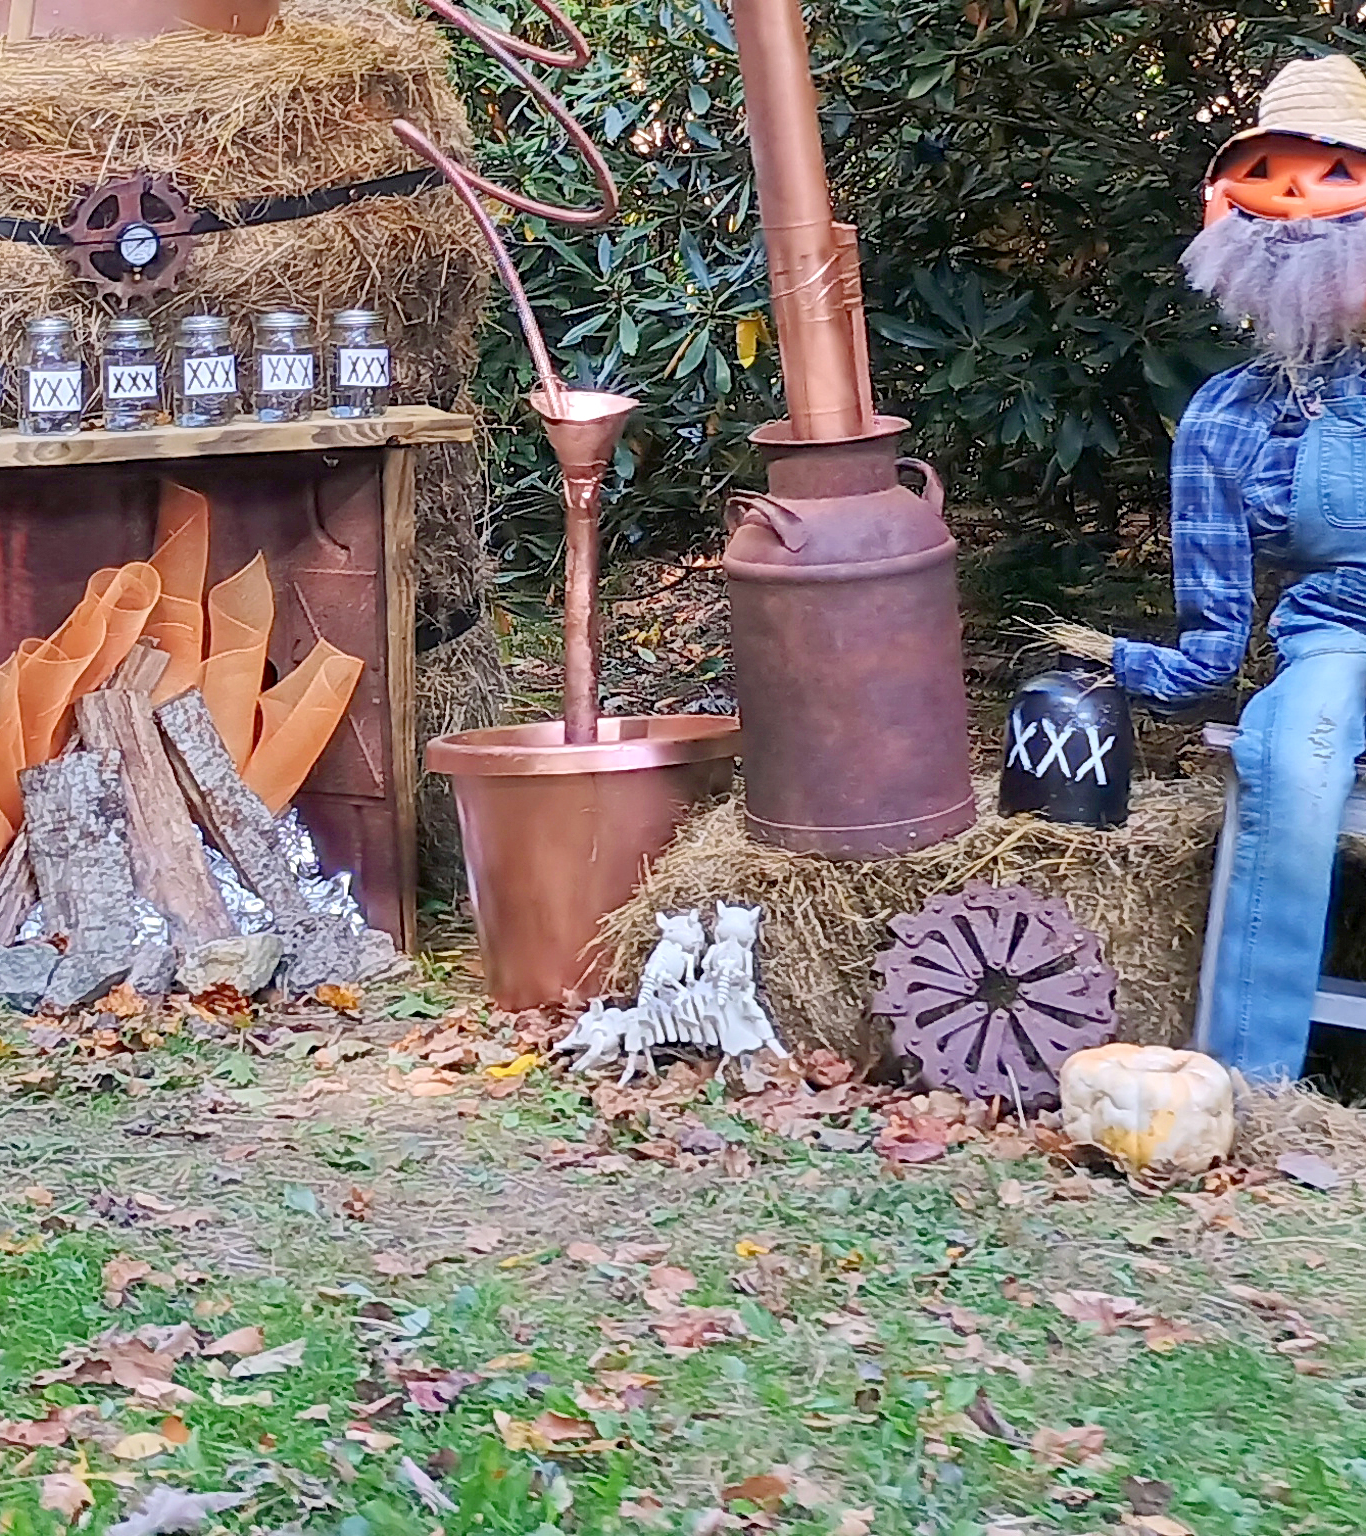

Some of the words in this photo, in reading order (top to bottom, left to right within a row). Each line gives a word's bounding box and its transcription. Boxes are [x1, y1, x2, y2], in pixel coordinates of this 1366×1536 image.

[113, 371, 153, 394] XXX
[187, 359, 234, 391] XXX
[269, 356, 311, 386] XXX
[346, 355, 388, 384] XXX
[33, 377, 82, 407] XXX
[1006, 701, 1116, 786] XXX
